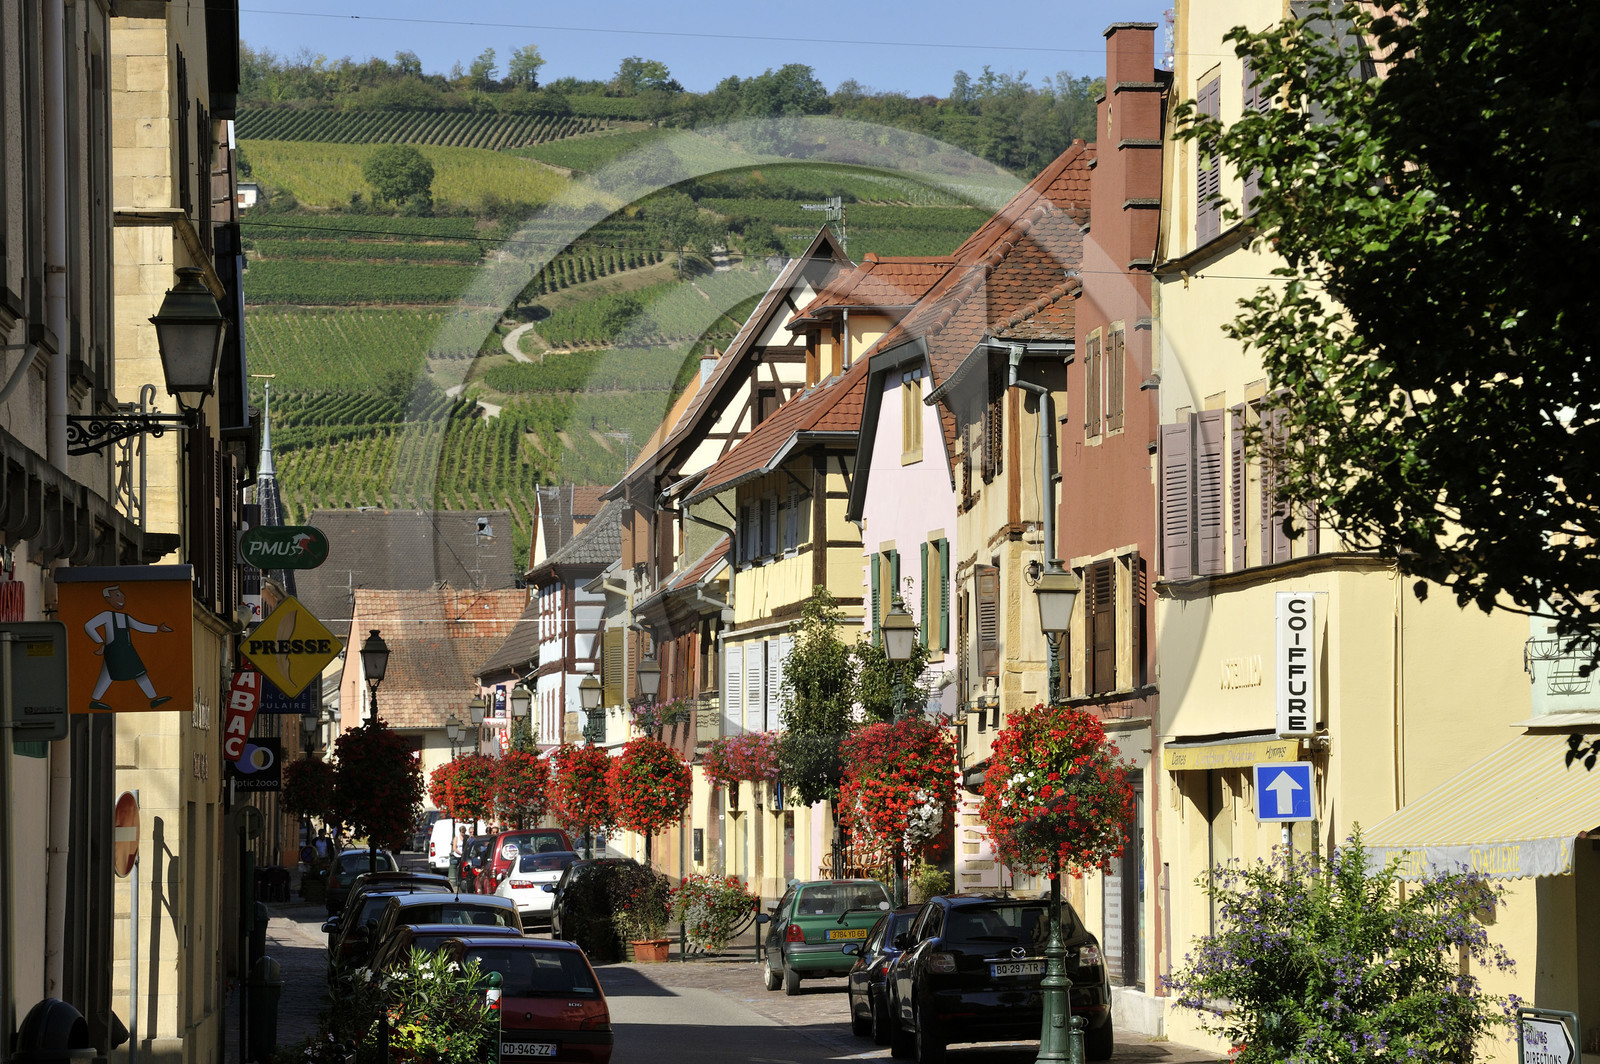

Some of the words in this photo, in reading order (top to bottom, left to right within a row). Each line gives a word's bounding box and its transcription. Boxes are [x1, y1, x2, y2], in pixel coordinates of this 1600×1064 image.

[248, 541, 291, 556] PMU
[248, 639, 331, 655] PRESSE
[1288, 599, 1307, 731] COIFFURE
[225, 668, 256, 757] ABAC
[255, 778, 279, 787] 2000
[1470, 845, 1520, 874] JOAILLERIE
[502, 1043, 551, 1055] CD-946-ZZ
